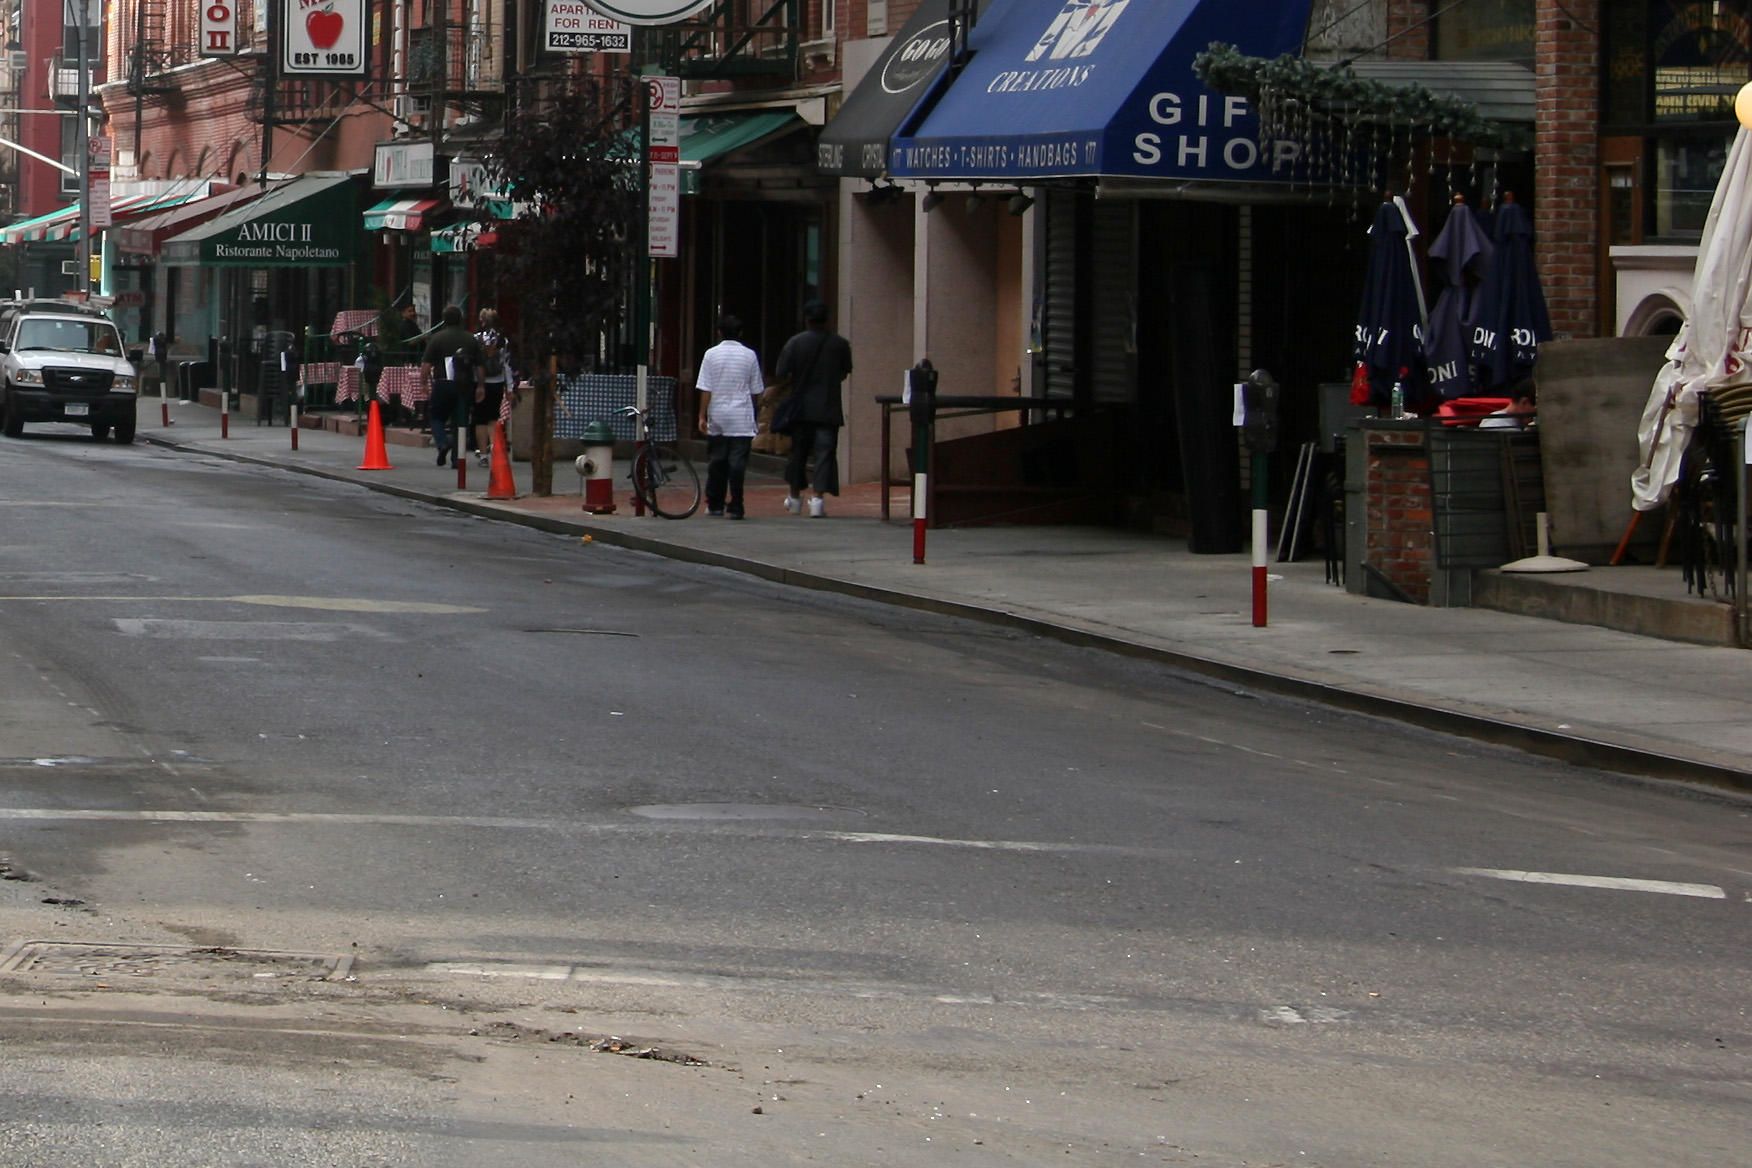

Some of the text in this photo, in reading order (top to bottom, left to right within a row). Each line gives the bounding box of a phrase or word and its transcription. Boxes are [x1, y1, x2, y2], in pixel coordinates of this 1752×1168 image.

[554, 17, 621, 31] FOR RENT
[552, 34, 625, 48] 212-965-1632
[900, 39, 930, 62] GO
[294, 52, 355, 65] EST 1985
[987, 64, 1096, 93] CREATIONS
[1148, 92, 1249, 128] GIF
[906, 146, 951, 169] WATCHES
[961, 144, 1008, 169] T-SHIRTS
[1017, 140, 1078, 168] HANDBAGS
[1133, 132, 1301, 173] SHOP
[237, 222, 312, 243] AMICI II
[215, 244, 339, 261] Ristorante Napoletano
